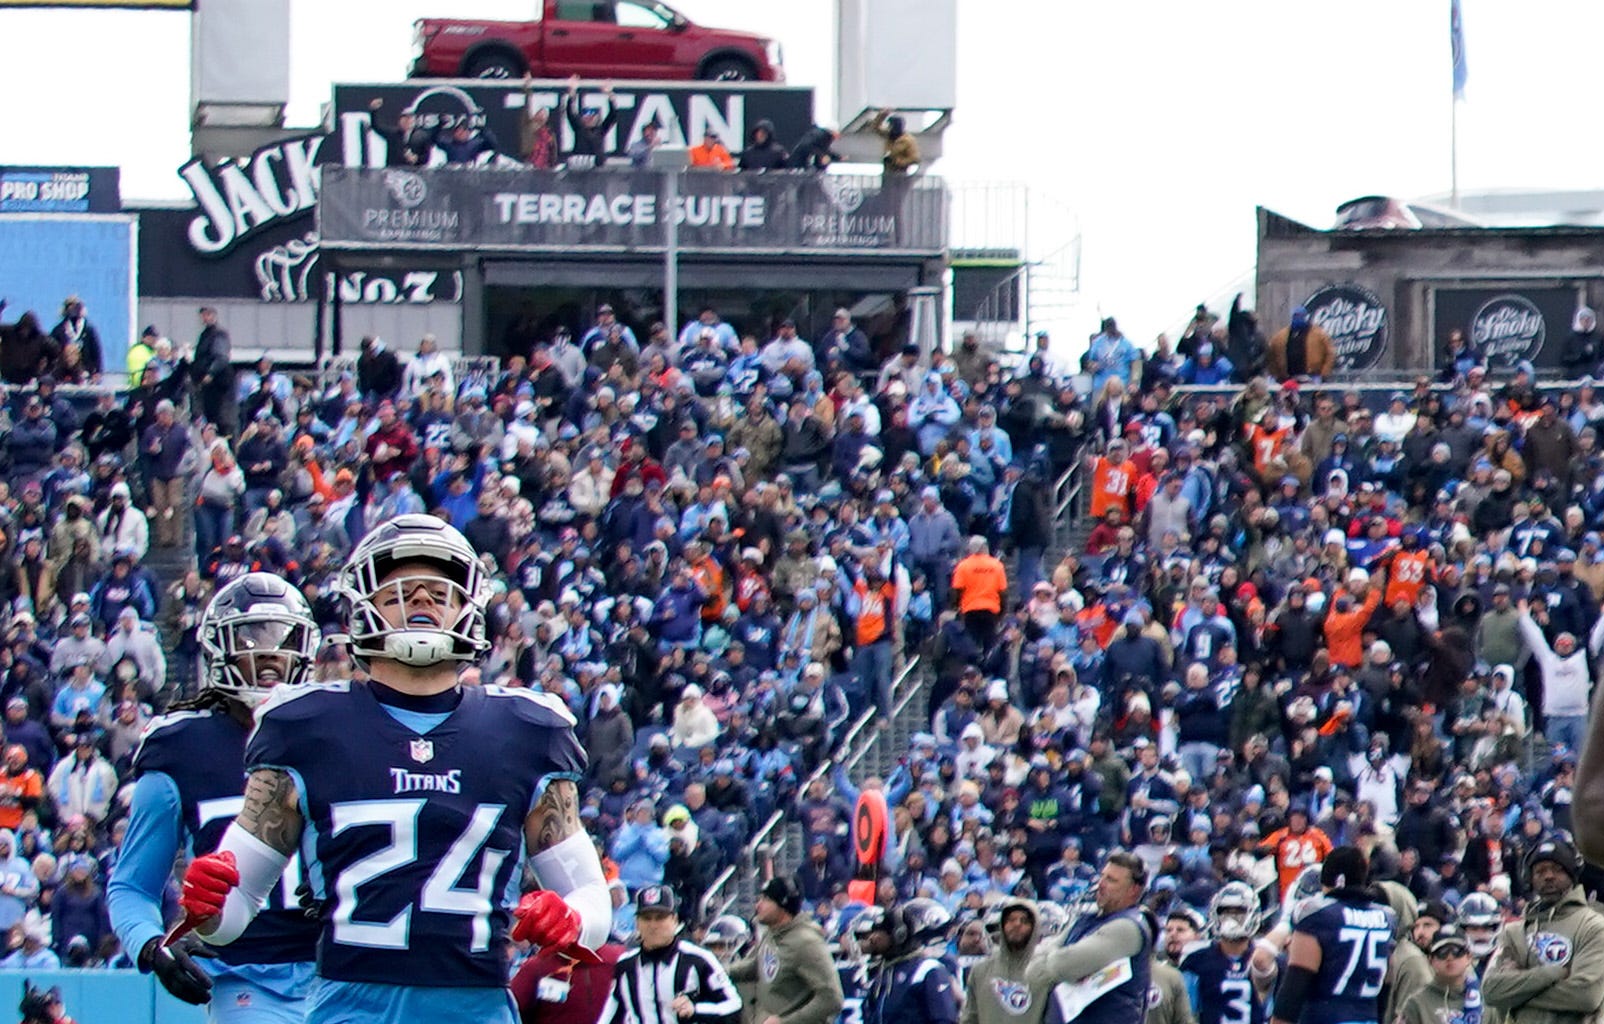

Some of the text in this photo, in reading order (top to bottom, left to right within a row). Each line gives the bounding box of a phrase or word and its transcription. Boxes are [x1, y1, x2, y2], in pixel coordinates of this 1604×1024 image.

[1, 181, 89, 200] PRO SHOP
[188, 136, 325, 253] JACK
[364, 209, 459, 229] PREMIUM
[495, 193, 766, 227] TERRACE SUITE
[801, 215, 896, 234] PREMIUM
[390, 767, 462, 795] TITANS
[329, 797, 511, 953] 24
[1333, 928, 1391, 998] 75
